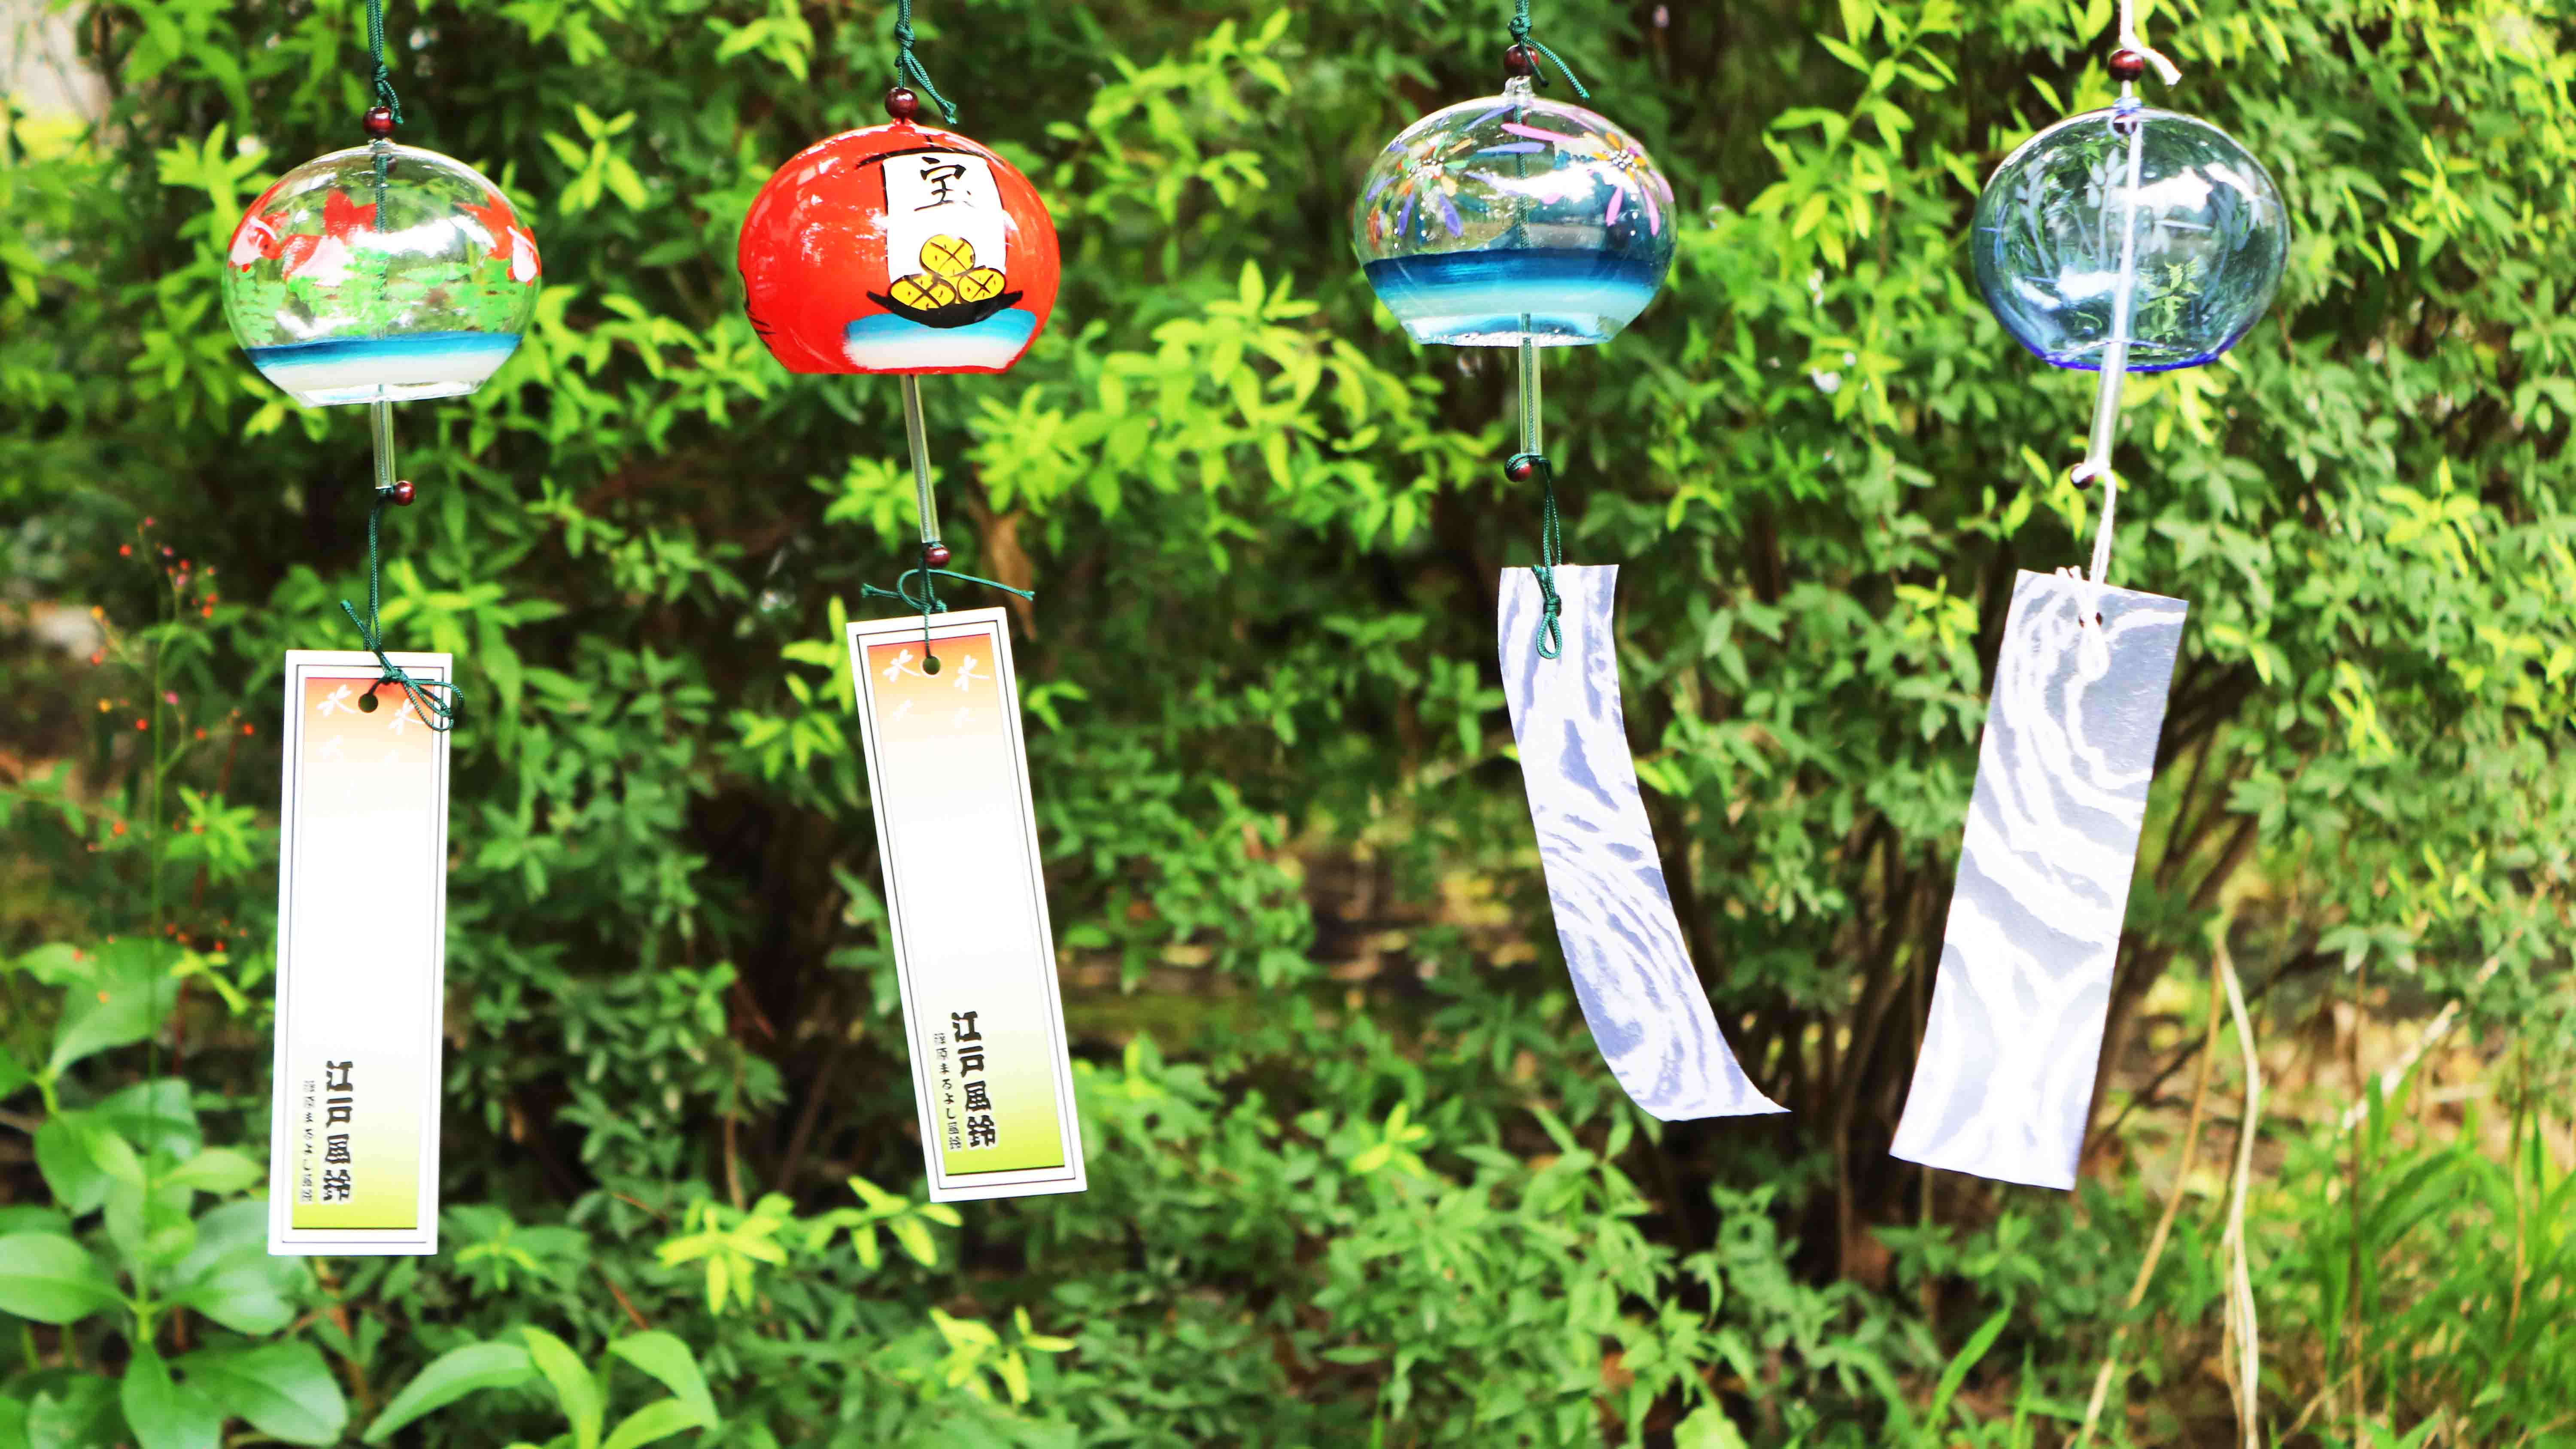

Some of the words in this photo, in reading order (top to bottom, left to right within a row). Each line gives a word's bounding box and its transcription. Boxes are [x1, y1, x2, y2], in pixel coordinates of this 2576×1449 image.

[914, 156, 975, 212] 宝
[323, 1060, 353, 1201] 江戸風鈴
[951, 1010, 996, 1148] 江戸風鈴
